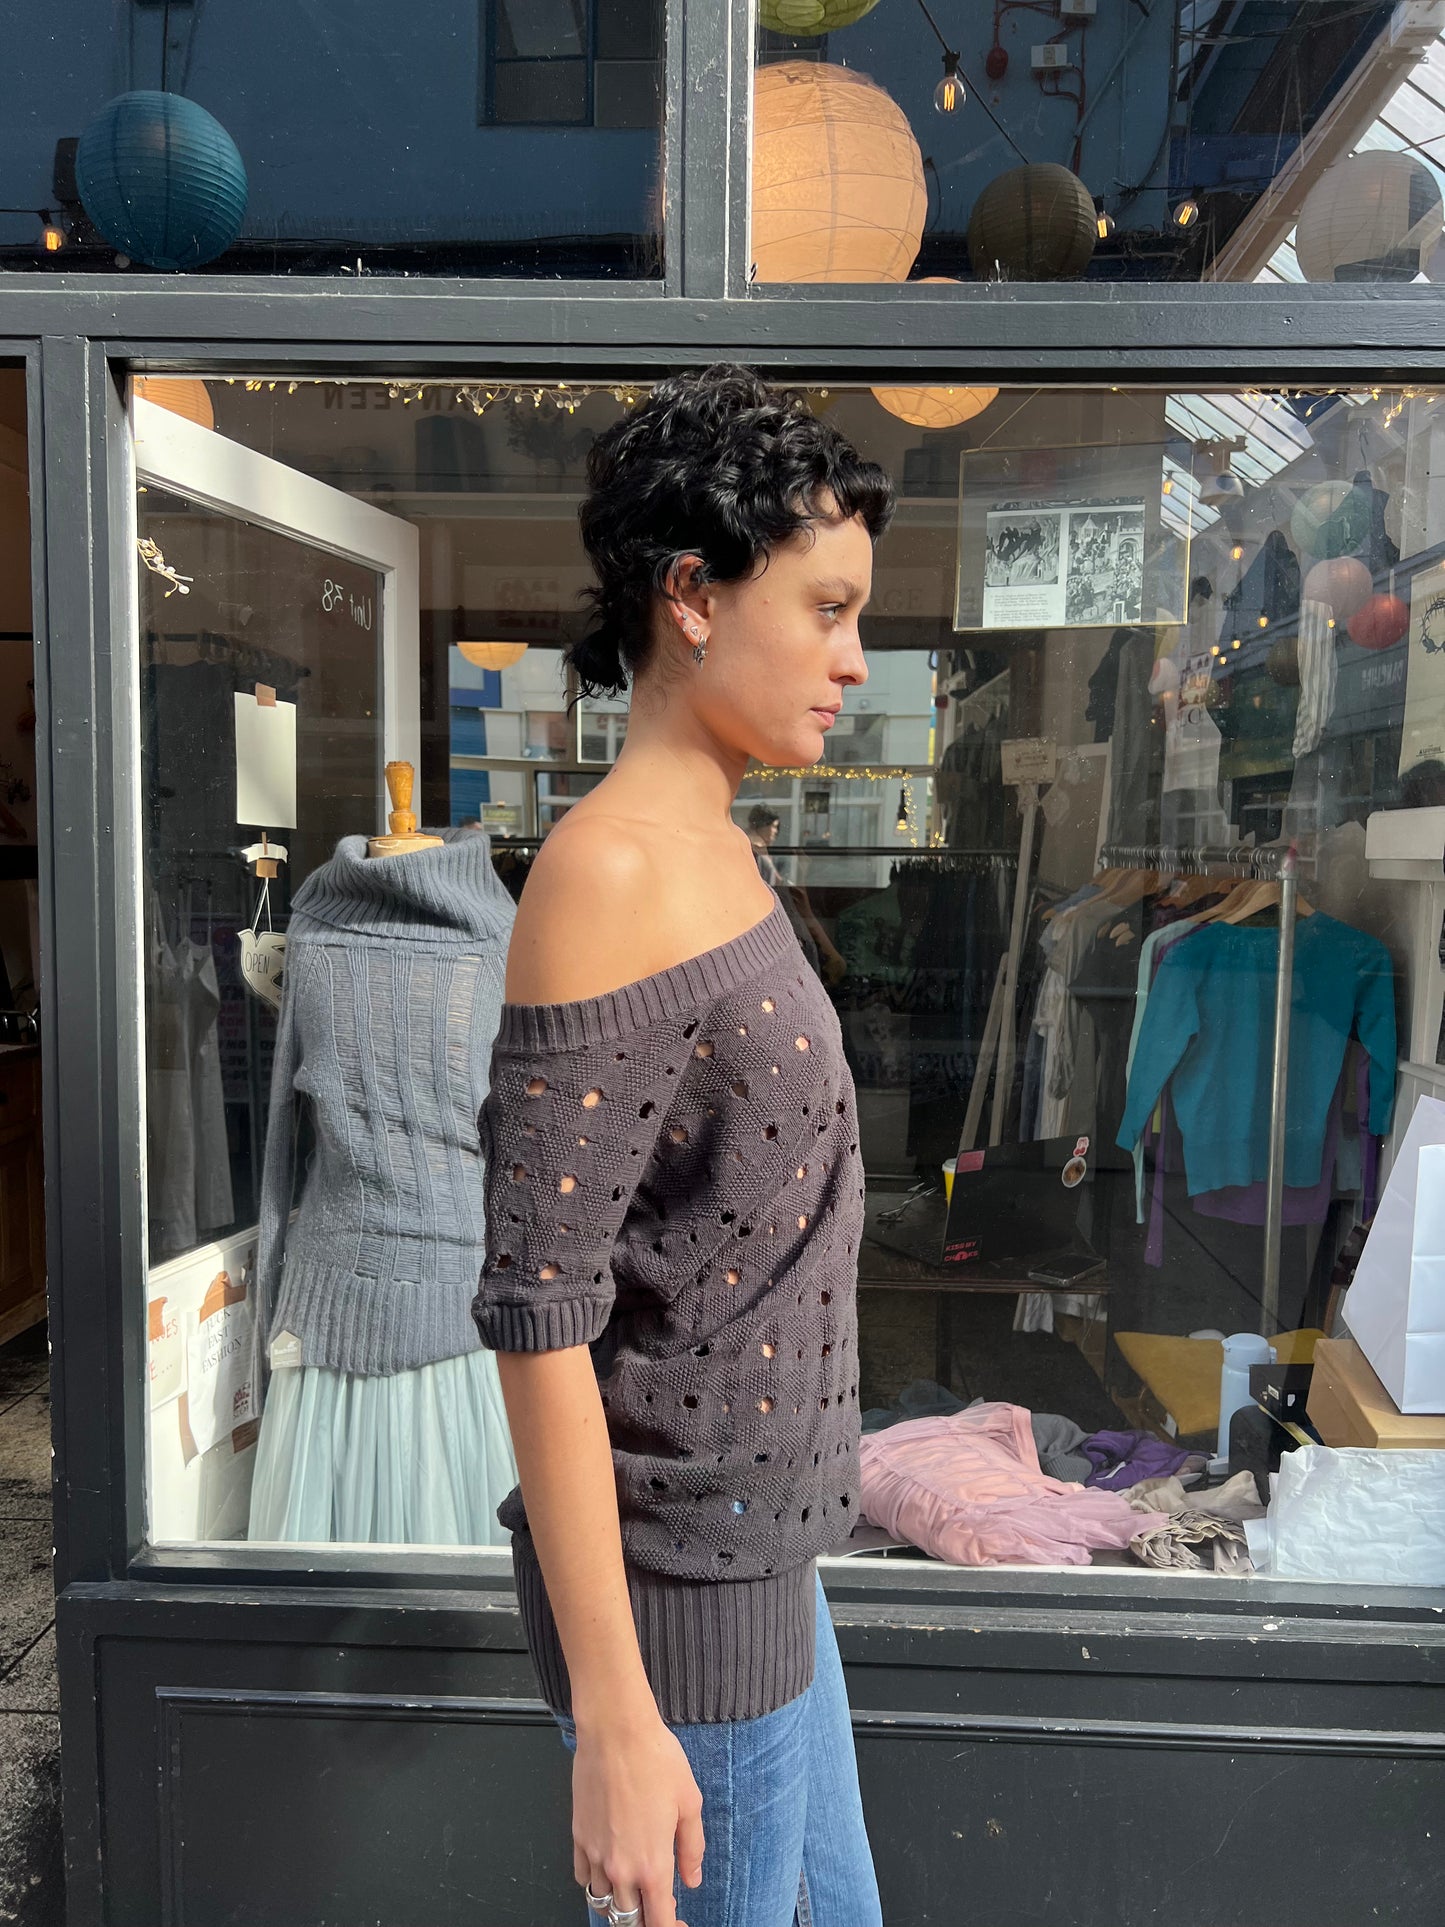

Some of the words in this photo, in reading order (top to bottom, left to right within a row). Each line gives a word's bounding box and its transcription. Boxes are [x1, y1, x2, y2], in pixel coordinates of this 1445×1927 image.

[244, 951, 271, 975] OPEN
[208, 1324, 230, 1349] FAST
[202, 1335, 243, 1374] FASHION
